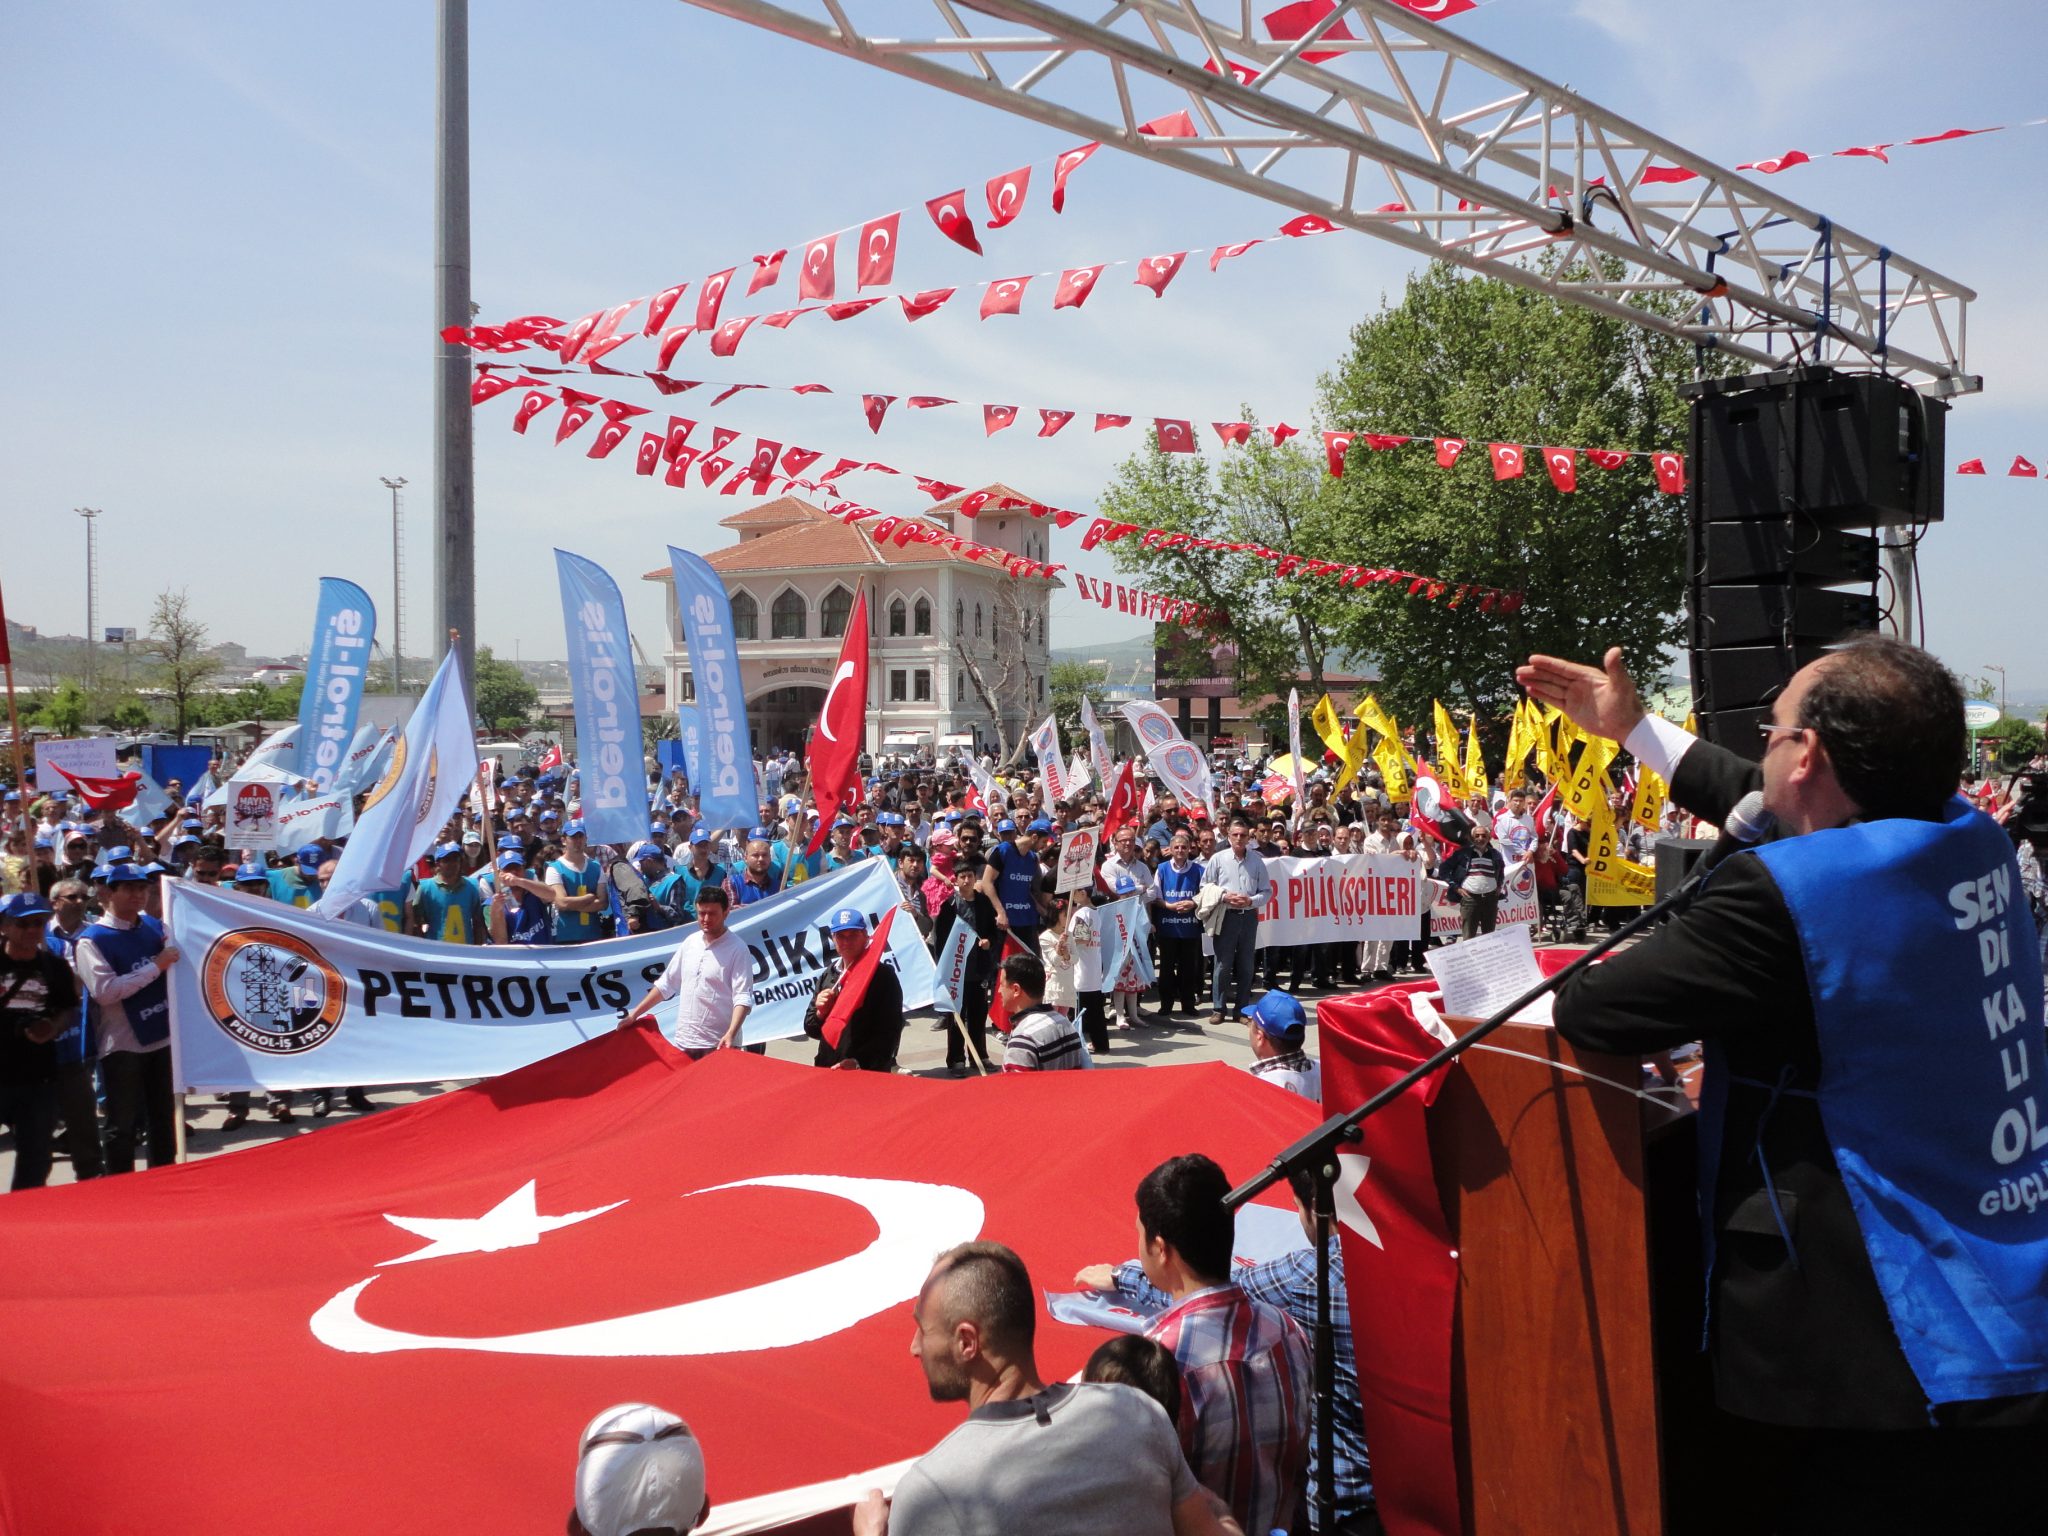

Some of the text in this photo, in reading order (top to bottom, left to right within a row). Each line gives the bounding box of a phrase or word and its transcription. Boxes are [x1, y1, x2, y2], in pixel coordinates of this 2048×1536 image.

[1572, 763, 1595, 804] ADD
[1594, 831, 1611, 873] ADD
[1009, 873, 1034, 882] GÖREV
[1288, 867, 1340, 925] PİLİÇ
[1338, 867, 1416, 926] İŞÇİLERİ
[1948, 863, 2010, 930] SEN
[444, 904, 466, 944] A
[1495, 902, 1538, 926] SİLCİLİĞİ
[1977, 922, 2010, 977] Dİ
[356, 965, 632, 1020] PETROL-İŞ
[753, 976, 820, 1006] BANDIR
[1982, 983, 2027, 1041] KA
[229, 1019, 328, 1050] PETROL-İŞ 1950
[1991, 1095, 2048, 1165] OL
